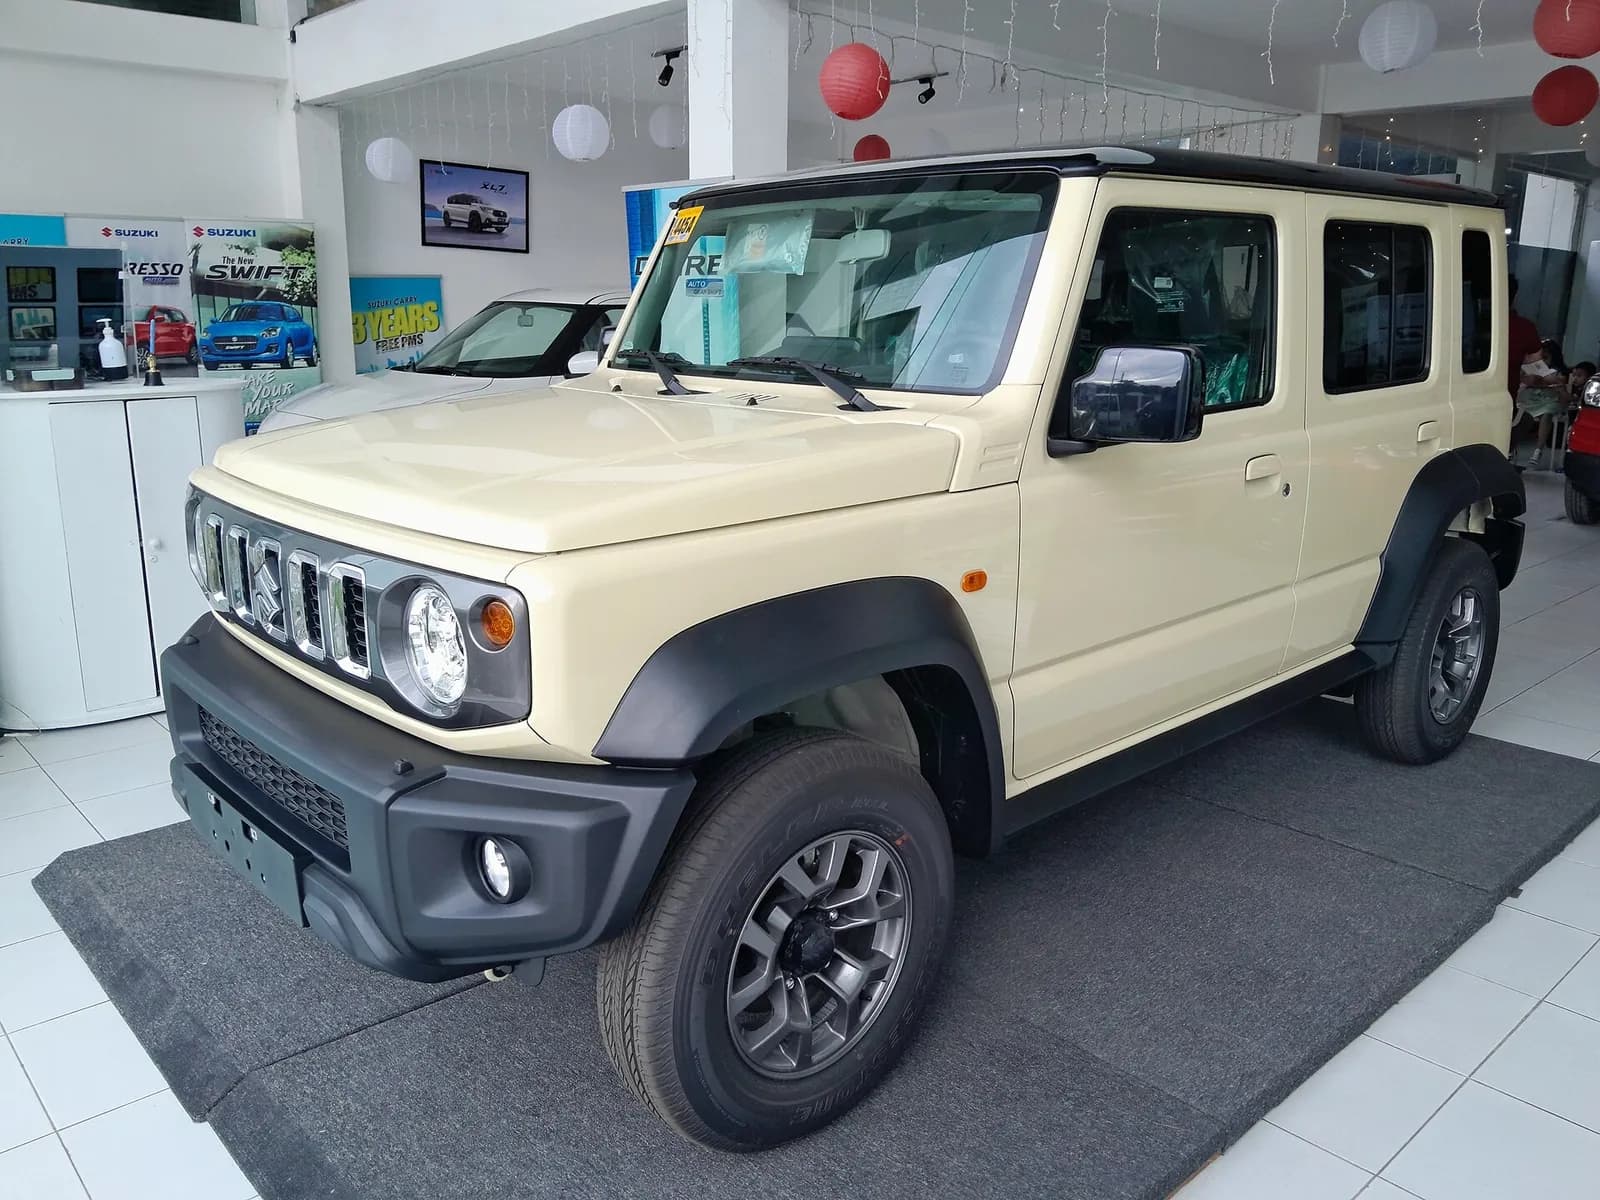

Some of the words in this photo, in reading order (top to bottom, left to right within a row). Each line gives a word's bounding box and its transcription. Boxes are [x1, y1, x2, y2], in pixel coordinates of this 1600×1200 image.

[481, 182, 506, 192] XL7
[114, 229, 159, 237] SUZUKI
[207, 228, 257, 237] SUZUKI
[222, 256, 235, 265] The
[238, 256, 254, 265] New
[206, 264, 306, 280] SWIFT
[352, 312, 367, 344] 3
[367, 301, 440, 342] YEARS
[401, 334, 424, 348] PMS
[252, 382, 295, 402] YOUR
